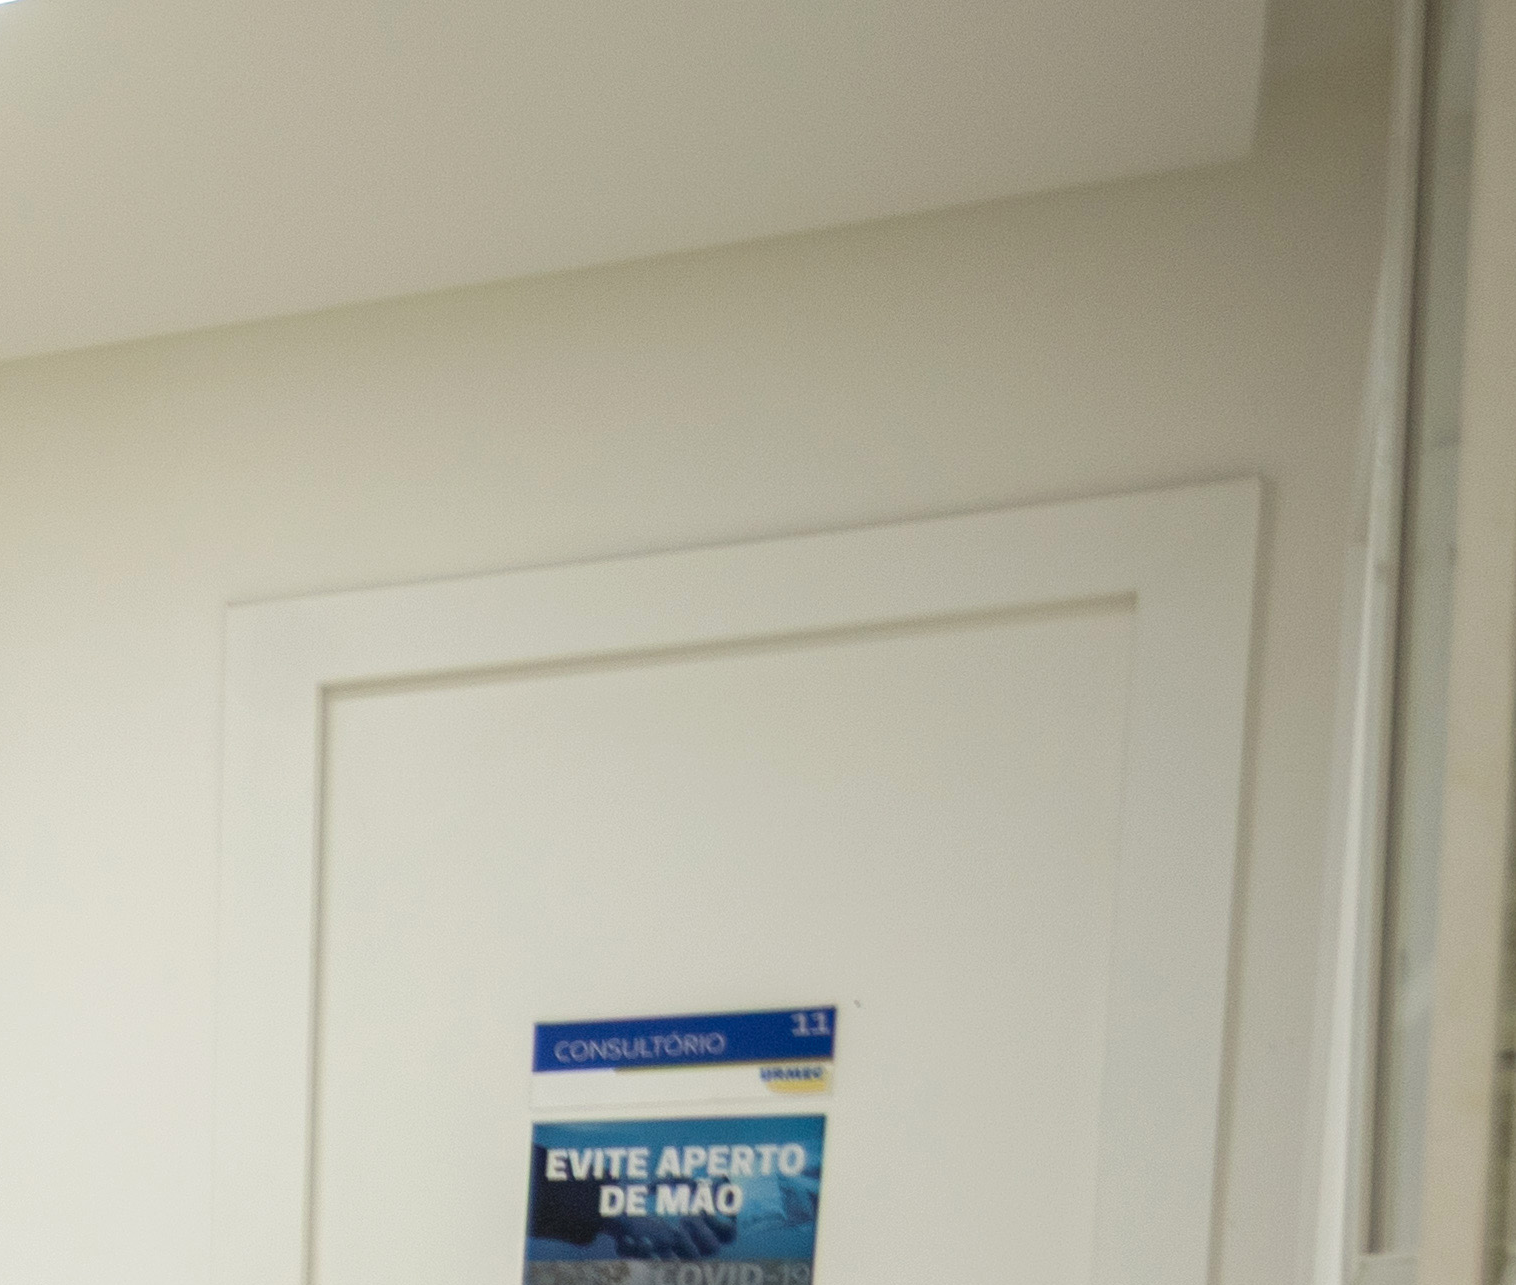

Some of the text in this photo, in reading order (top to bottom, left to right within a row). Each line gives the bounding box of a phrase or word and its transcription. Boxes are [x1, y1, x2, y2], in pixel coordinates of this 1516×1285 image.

[790, 1012, 830, 1037] 11
[554, 1031, 726, 1063] CONSULTÓRIO
[545, 1143, 806, 1182] EVITE APERTO
[600, 1180, 743, 1217] DE MÃO
